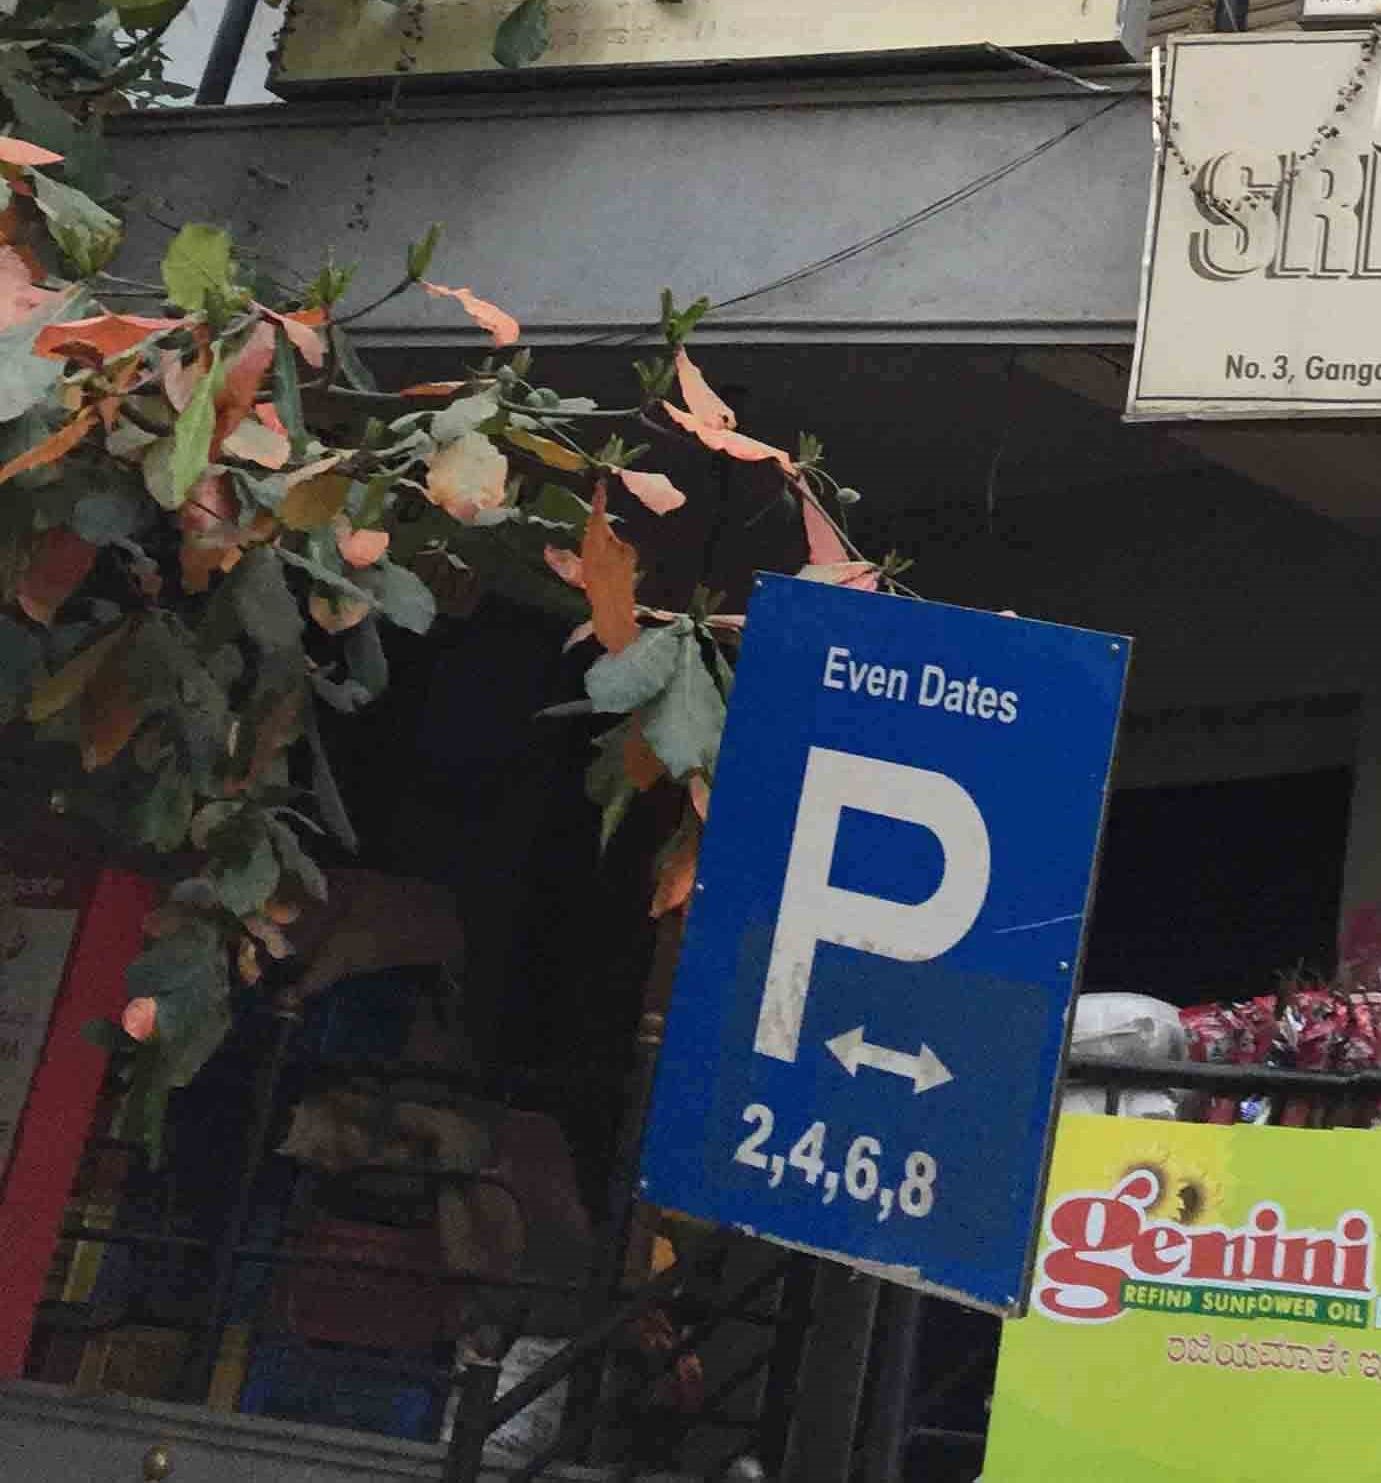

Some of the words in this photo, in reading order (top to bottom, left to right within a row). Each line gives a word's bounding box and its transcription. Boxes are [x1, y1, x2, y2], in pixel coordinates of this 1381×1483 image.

[821, 645, 911, 704] Even
[916, 664, 1021, 725] Dates
[753, 744, 993, 1065] P
[733, 1102, 940, 1223] 2,4,6,8
[1327, 1302, 1366, 1324] OIL
